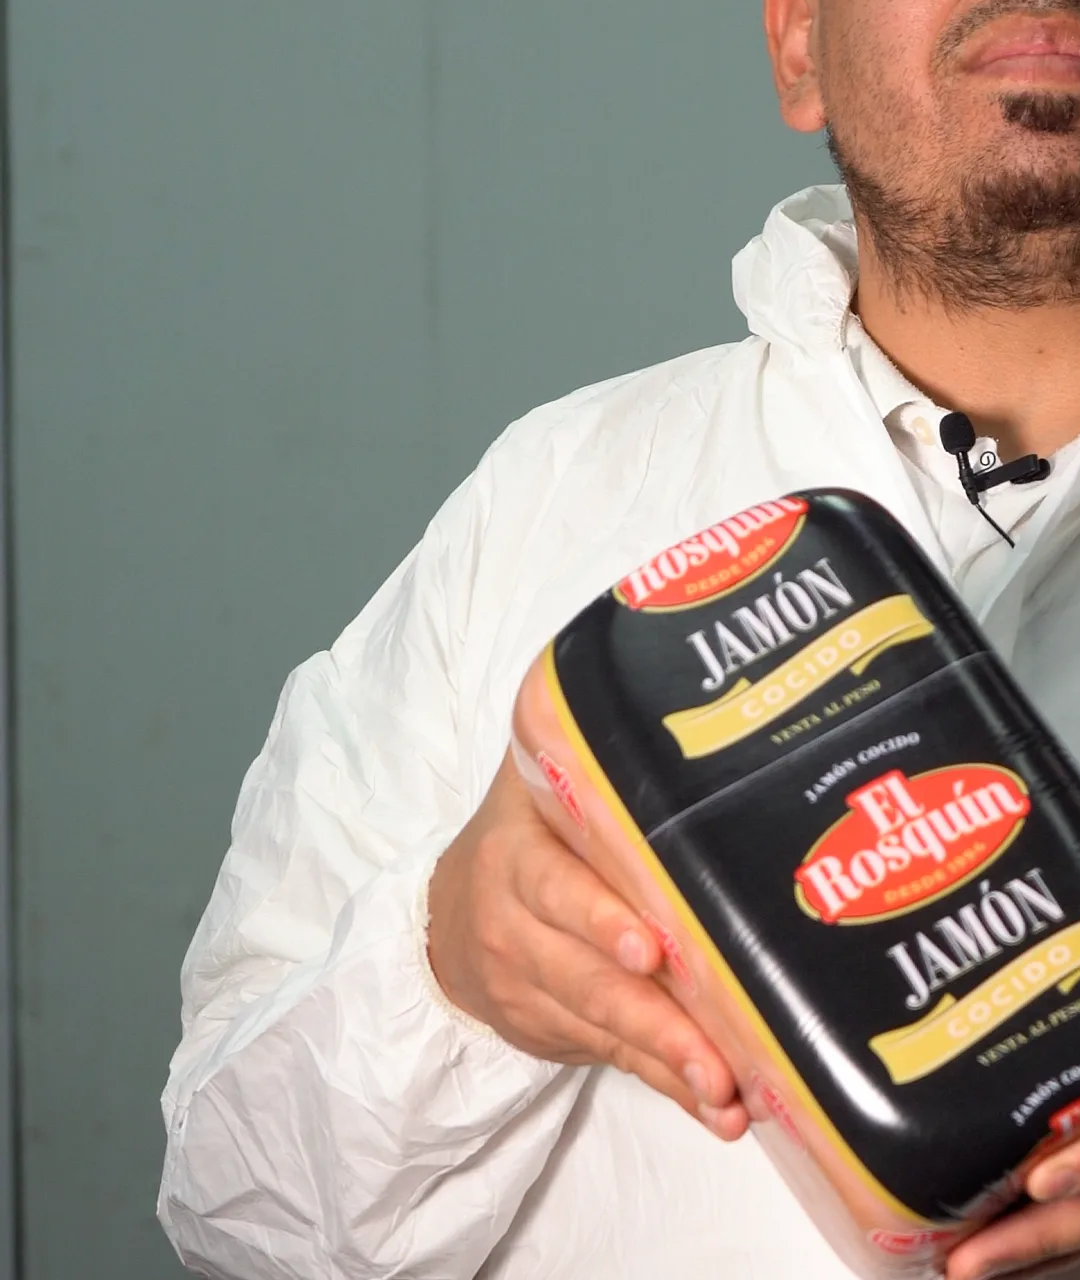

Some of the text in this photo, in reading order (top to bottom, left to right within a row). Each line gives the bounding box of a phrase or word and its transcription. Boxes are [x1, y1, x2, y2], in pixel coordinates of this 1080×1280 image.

[684, 564, 743, 595] DESDE
[686, 558, 854, 692] JAMÓN
[741, 629, 862, 718] COCIDO
[769, 679, 881, 745] VENTA AL PESO
[804, 731, 921, 804] JAMÓN COCIDO
[855, 775, 925, 834] El
[804, 779, 1025, 915] Rosquín
[883, 870, 947, 904] DESDE
[885, 868, 1066, 1011] JAMÓN
[947, 944, 1071, 1038] COCIDO
[976, 1032, 1028, 1067] VENTA
[1029, 1019, 1050, 1038] AL
[1010, 1077, 1061, 1127] JAMÓN
